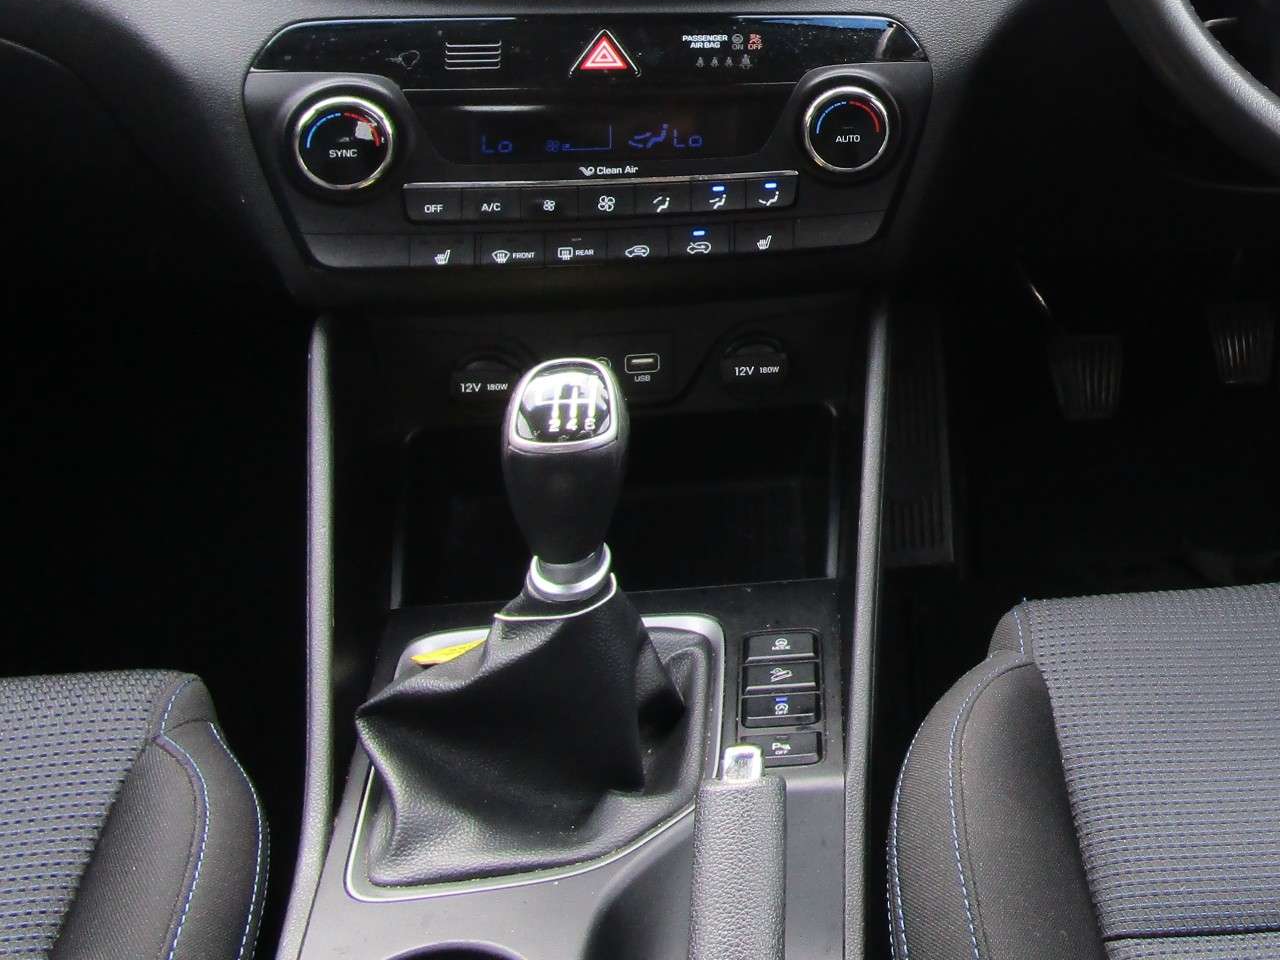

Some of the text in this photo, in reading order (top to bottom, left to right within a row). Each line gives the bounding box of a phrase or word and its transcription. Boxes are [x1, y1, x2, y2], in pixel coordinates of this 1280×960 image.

[682, 34, 728, 43] PASSENGER
[690, 41, 721, 49] AIR BAG
[835, 134, 861, 143] AUTO
[328, 148, 359, 158] SYNC
[596, 165, 639, 175] Clean Air
[424, 204, 444, 214] OFF
[481, 202, 502, 212] A/C
[512, 251, 536, 260] FRONT
[575, 249, 595, 257] REAR
[734, 366, 755, 377] 12V
[634, 375, 651, 383] USB
[460, 382, 482, 393] 12V
